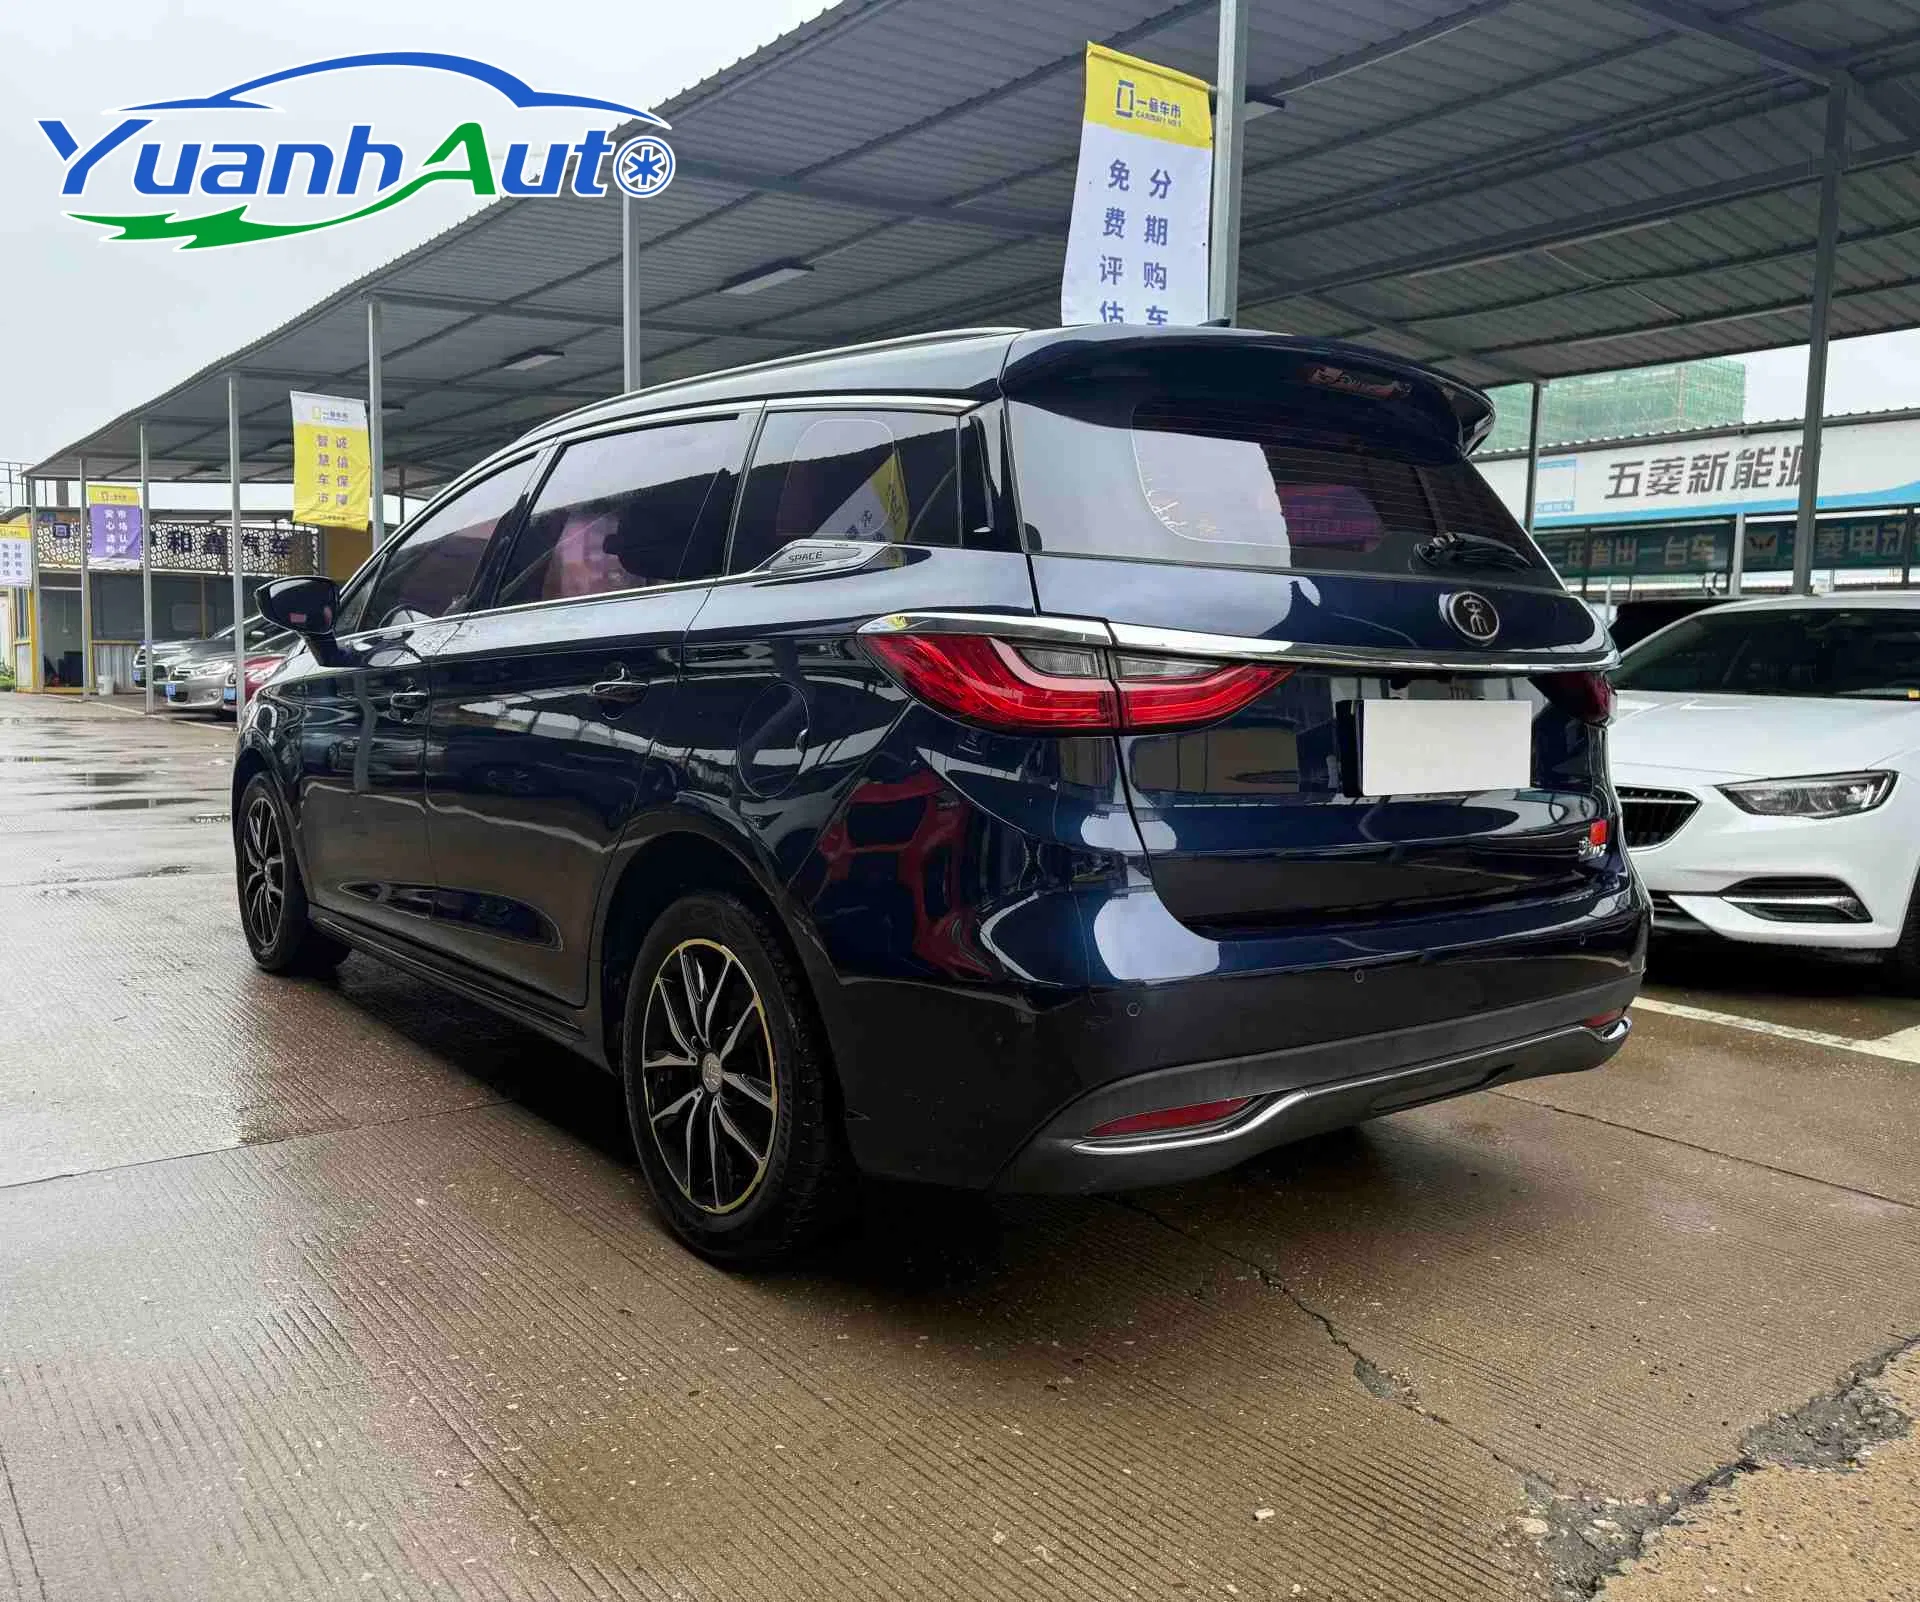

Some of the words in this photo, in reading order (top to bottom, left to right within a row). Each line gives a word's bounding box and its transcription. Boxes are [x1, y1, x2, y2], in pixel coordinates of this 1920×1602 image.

[1098, 158, 1131, 325] 免费评估
[1143, 167, 1173, 327] 分期购车
[788, 550, 823, 563] SPACE
